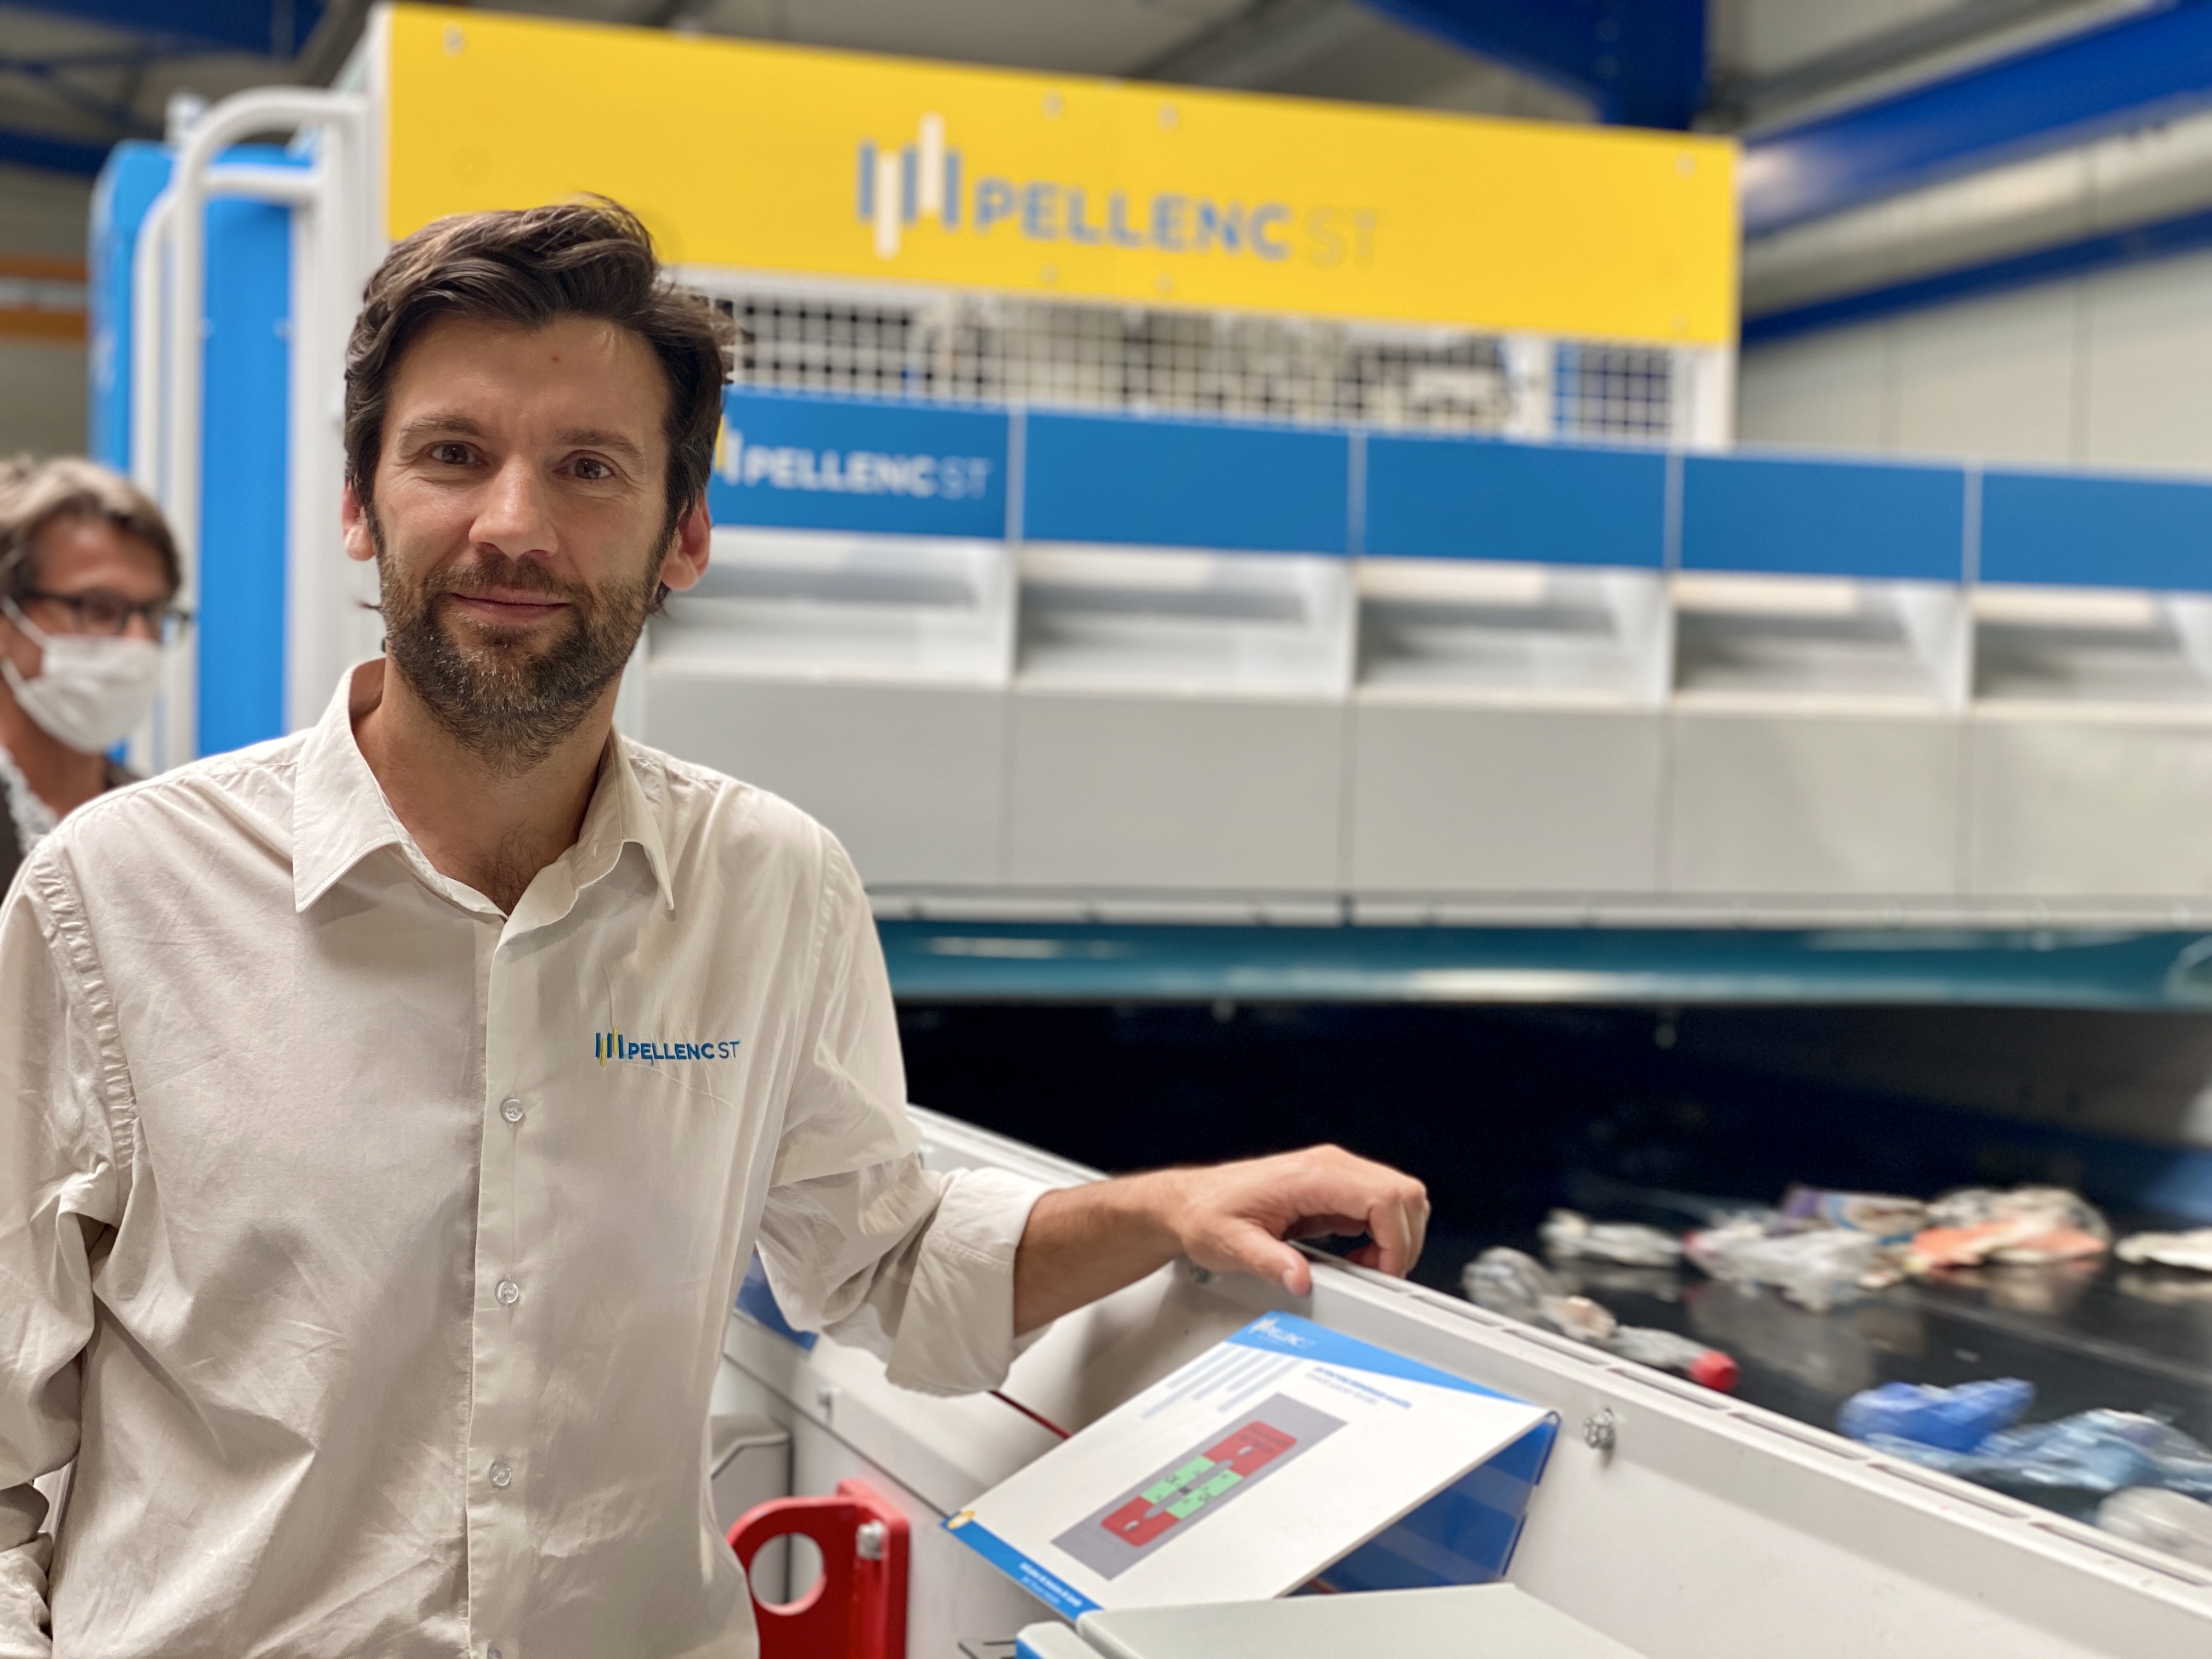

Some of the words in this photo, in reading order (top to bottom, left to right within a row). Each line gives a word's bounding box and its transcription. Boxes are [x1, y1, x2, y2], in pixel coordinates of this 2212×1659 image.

[973, 176, 1295, 263] PELLENC
[1305, 204, 1383, 269] ST
[743, 444, 936, 498] PELLENC
[936, 455, 994, 501] ST
[628, 1042, 715, 1060] PELLENC
[718, 1041, 741, 1059] ST
